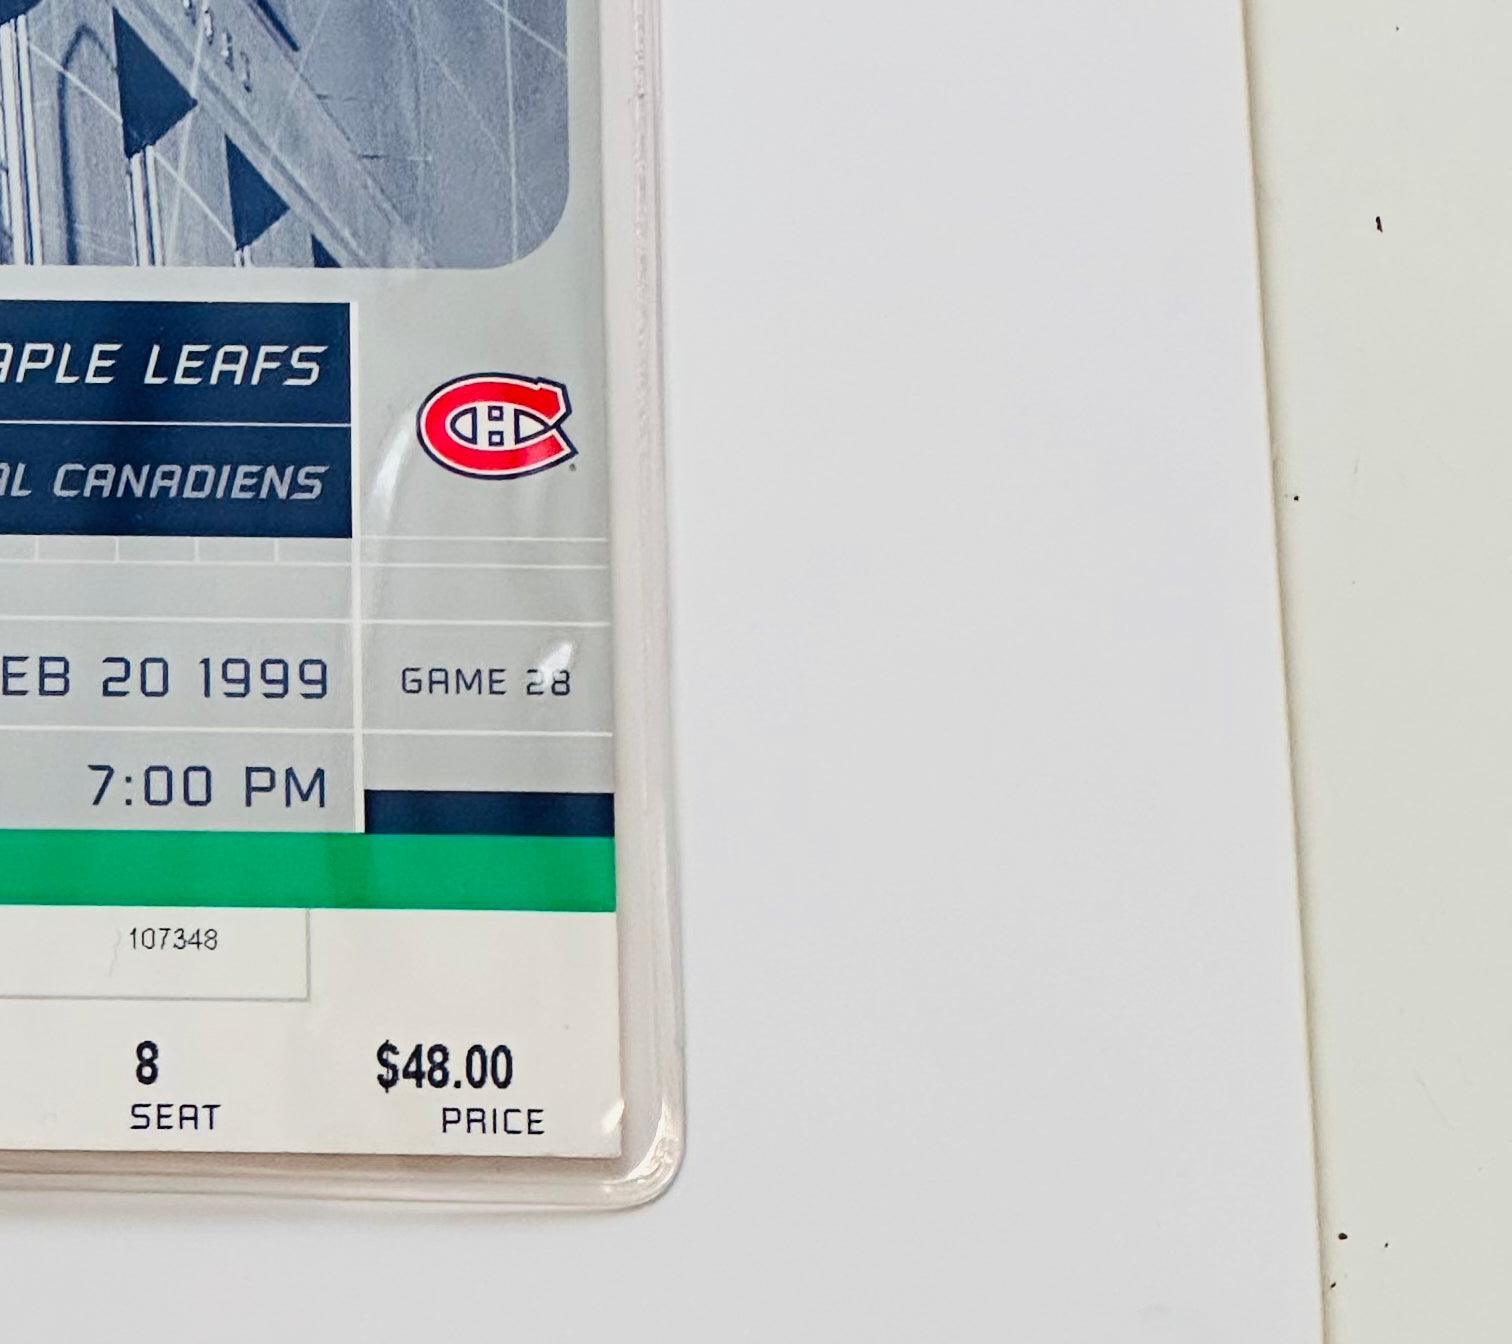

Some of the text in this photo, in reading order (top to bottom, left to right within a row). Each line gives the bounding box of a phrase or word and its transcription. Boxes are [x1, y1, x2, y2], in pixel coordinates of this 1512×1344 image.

[144, 345, 328, 385] LEAFS
[53, 464, 329, 499] CANADIENS
[103, 657, 168, 697] 20
[200, 658, 327, 699] 1999
[402, 668, 570, 696] GAME 28
[88, 765, 325, 808] 7:00 PM
[130, 928, 217, 950] 107348
[136, 1041, 158, 1085] 8
[377, 1040, 512, 1090] $48.00
[130, 1104, 221, 1130] SEAT
[443, 1108, 544, 1134] PRICE
